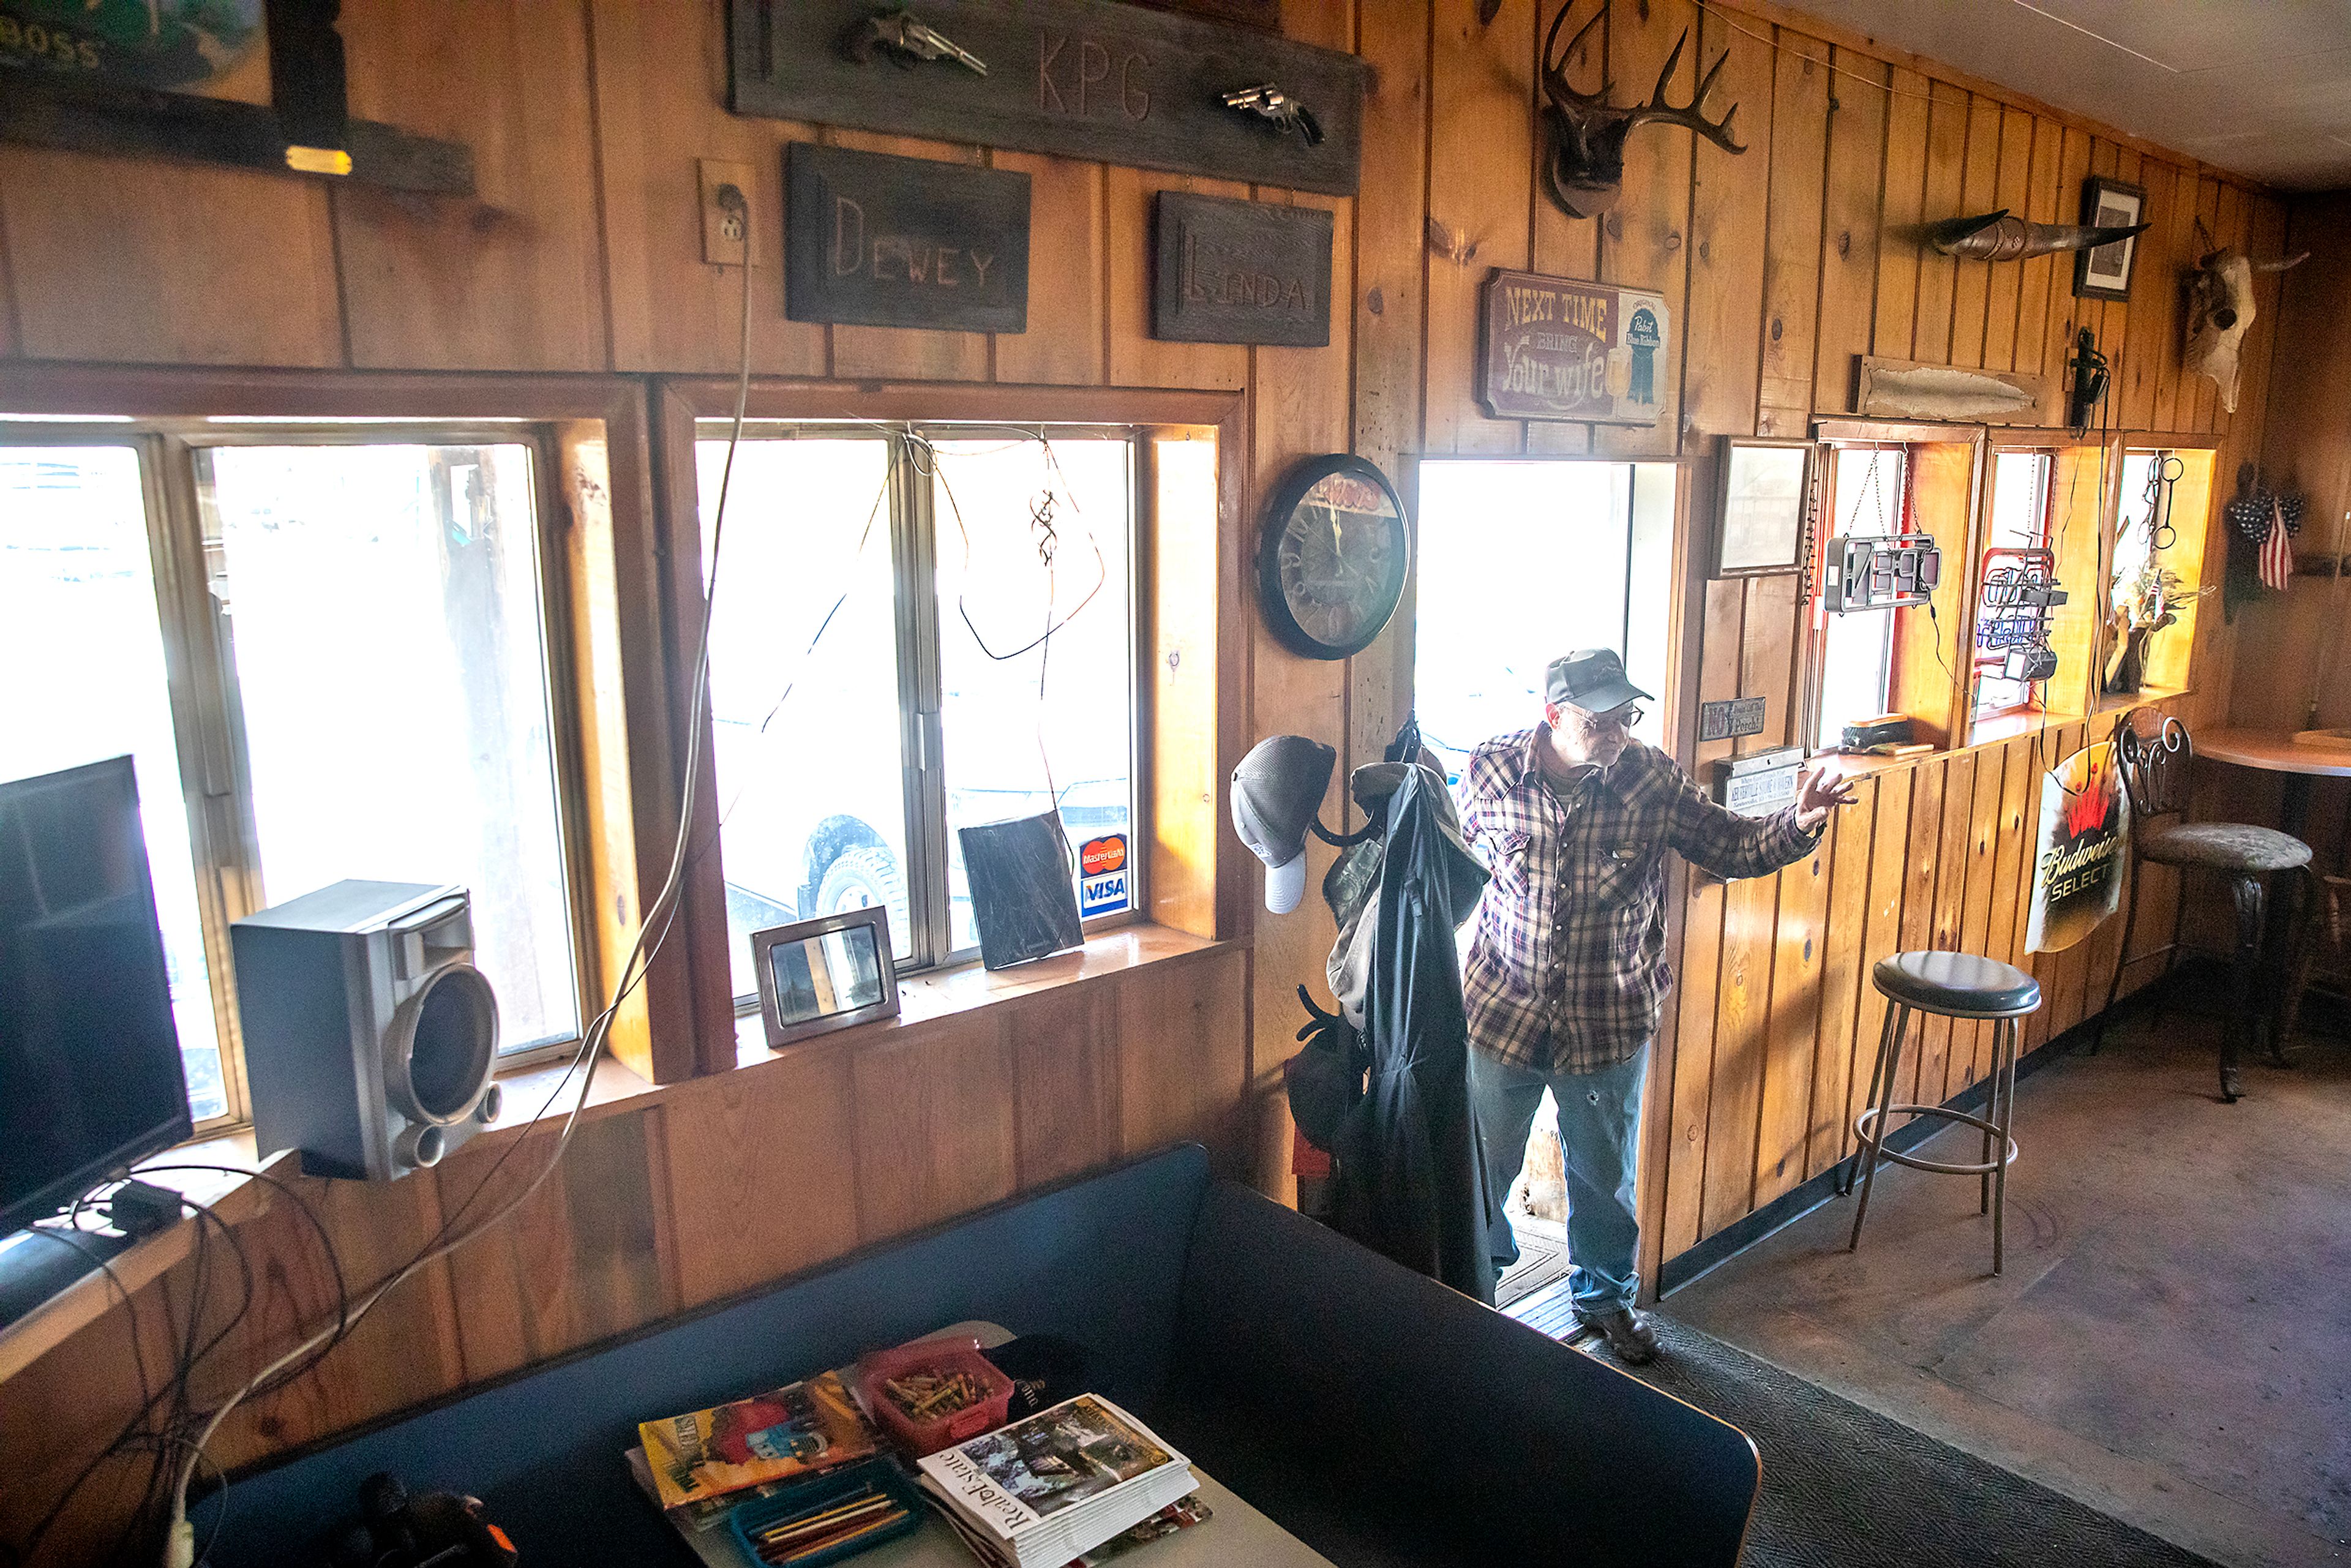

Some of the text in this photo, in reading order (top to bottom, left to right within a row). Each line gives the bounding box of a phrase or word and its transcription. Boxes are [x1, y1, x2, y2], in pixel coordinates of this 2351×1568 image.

[1040, 31, 1151, 122] KPG
[1504, 286, 1607, 343] NEXT TIME
[1634, 315, 1653, 332] Pabst
[1537, 332, 1578, 353] BRING
[1627, 332, 1660, 348] Blue Ribbon
[1502, 335, 1550, 395] Your
[1707, 705, 1725, 735] NO
[1735, 715, 1759, 733] Porch!
[1083, 847, 1125, 865] MasterCard
[1086, 878, 1125, 901] VISA
[2050, 863, 2109, 902] SELECT
[939, 1453, 1030, 1530] Real Estate
